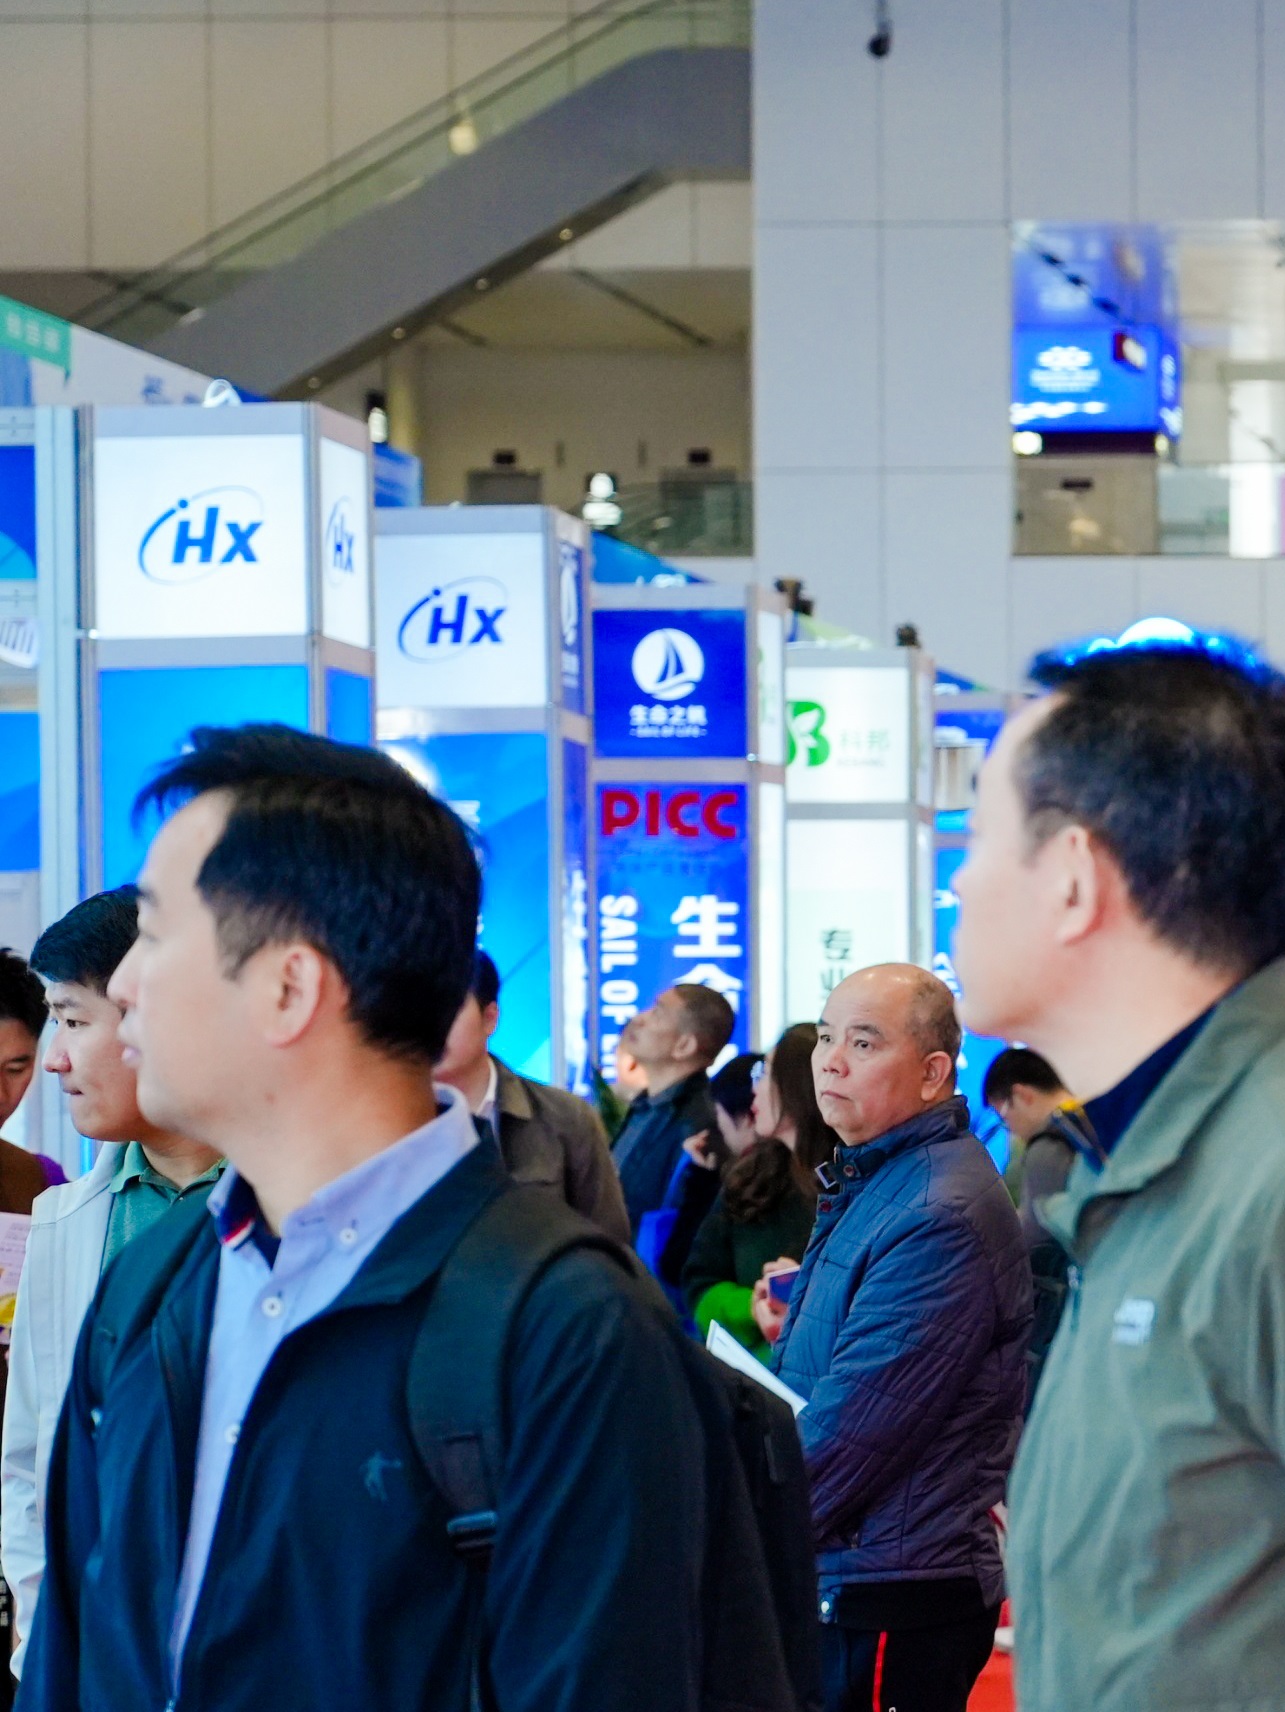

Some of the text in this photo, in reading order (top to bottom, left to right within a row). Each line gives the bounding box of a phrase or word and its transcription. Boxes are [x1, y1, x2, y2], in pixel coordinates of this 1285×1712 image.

[602, 790, 737, 838] PICC
[600, 894, 638, 974] SAIL
[601, 979, 639, 1026] OF
